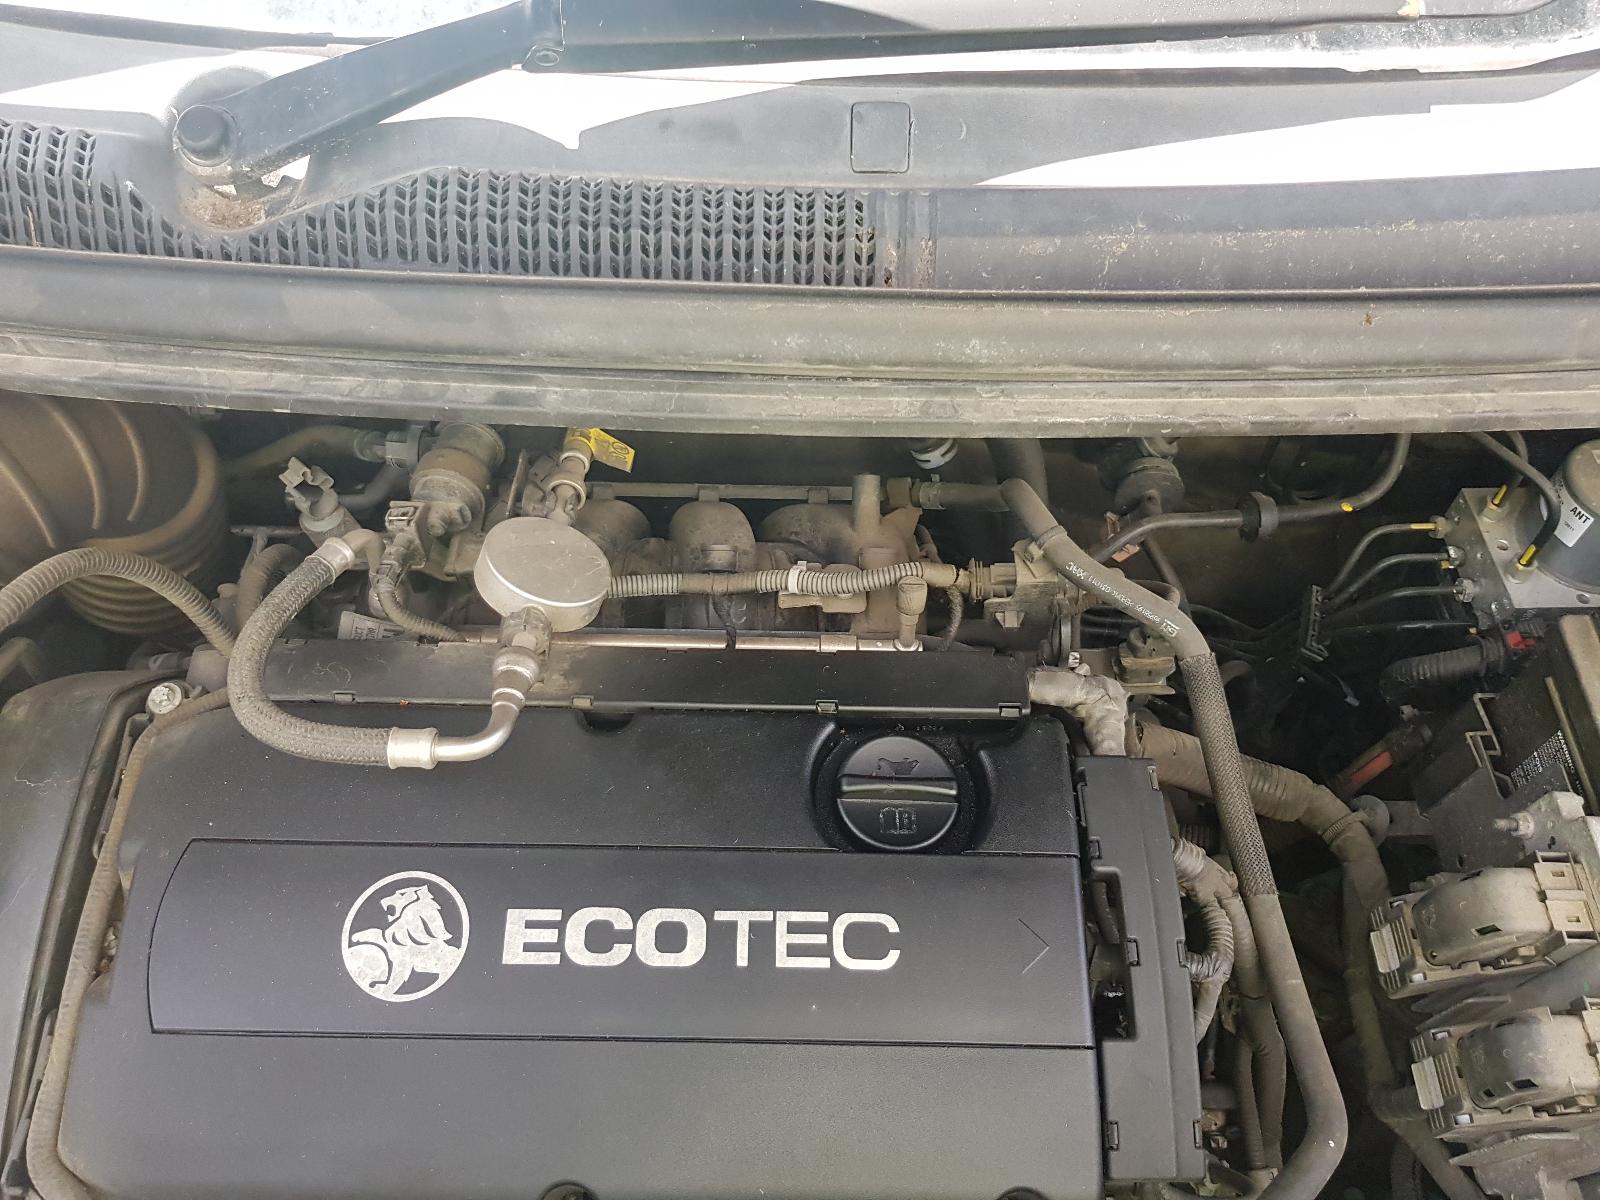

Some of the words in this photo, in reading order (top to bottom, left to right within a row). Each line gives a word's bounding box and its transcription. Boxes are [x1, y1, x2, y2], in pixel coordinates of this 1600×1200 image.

[1570, 506, 1590, 524] ANT
[1160, 619, 1180, 637] GM
[502, 907, 900, 970] ECOTEC
